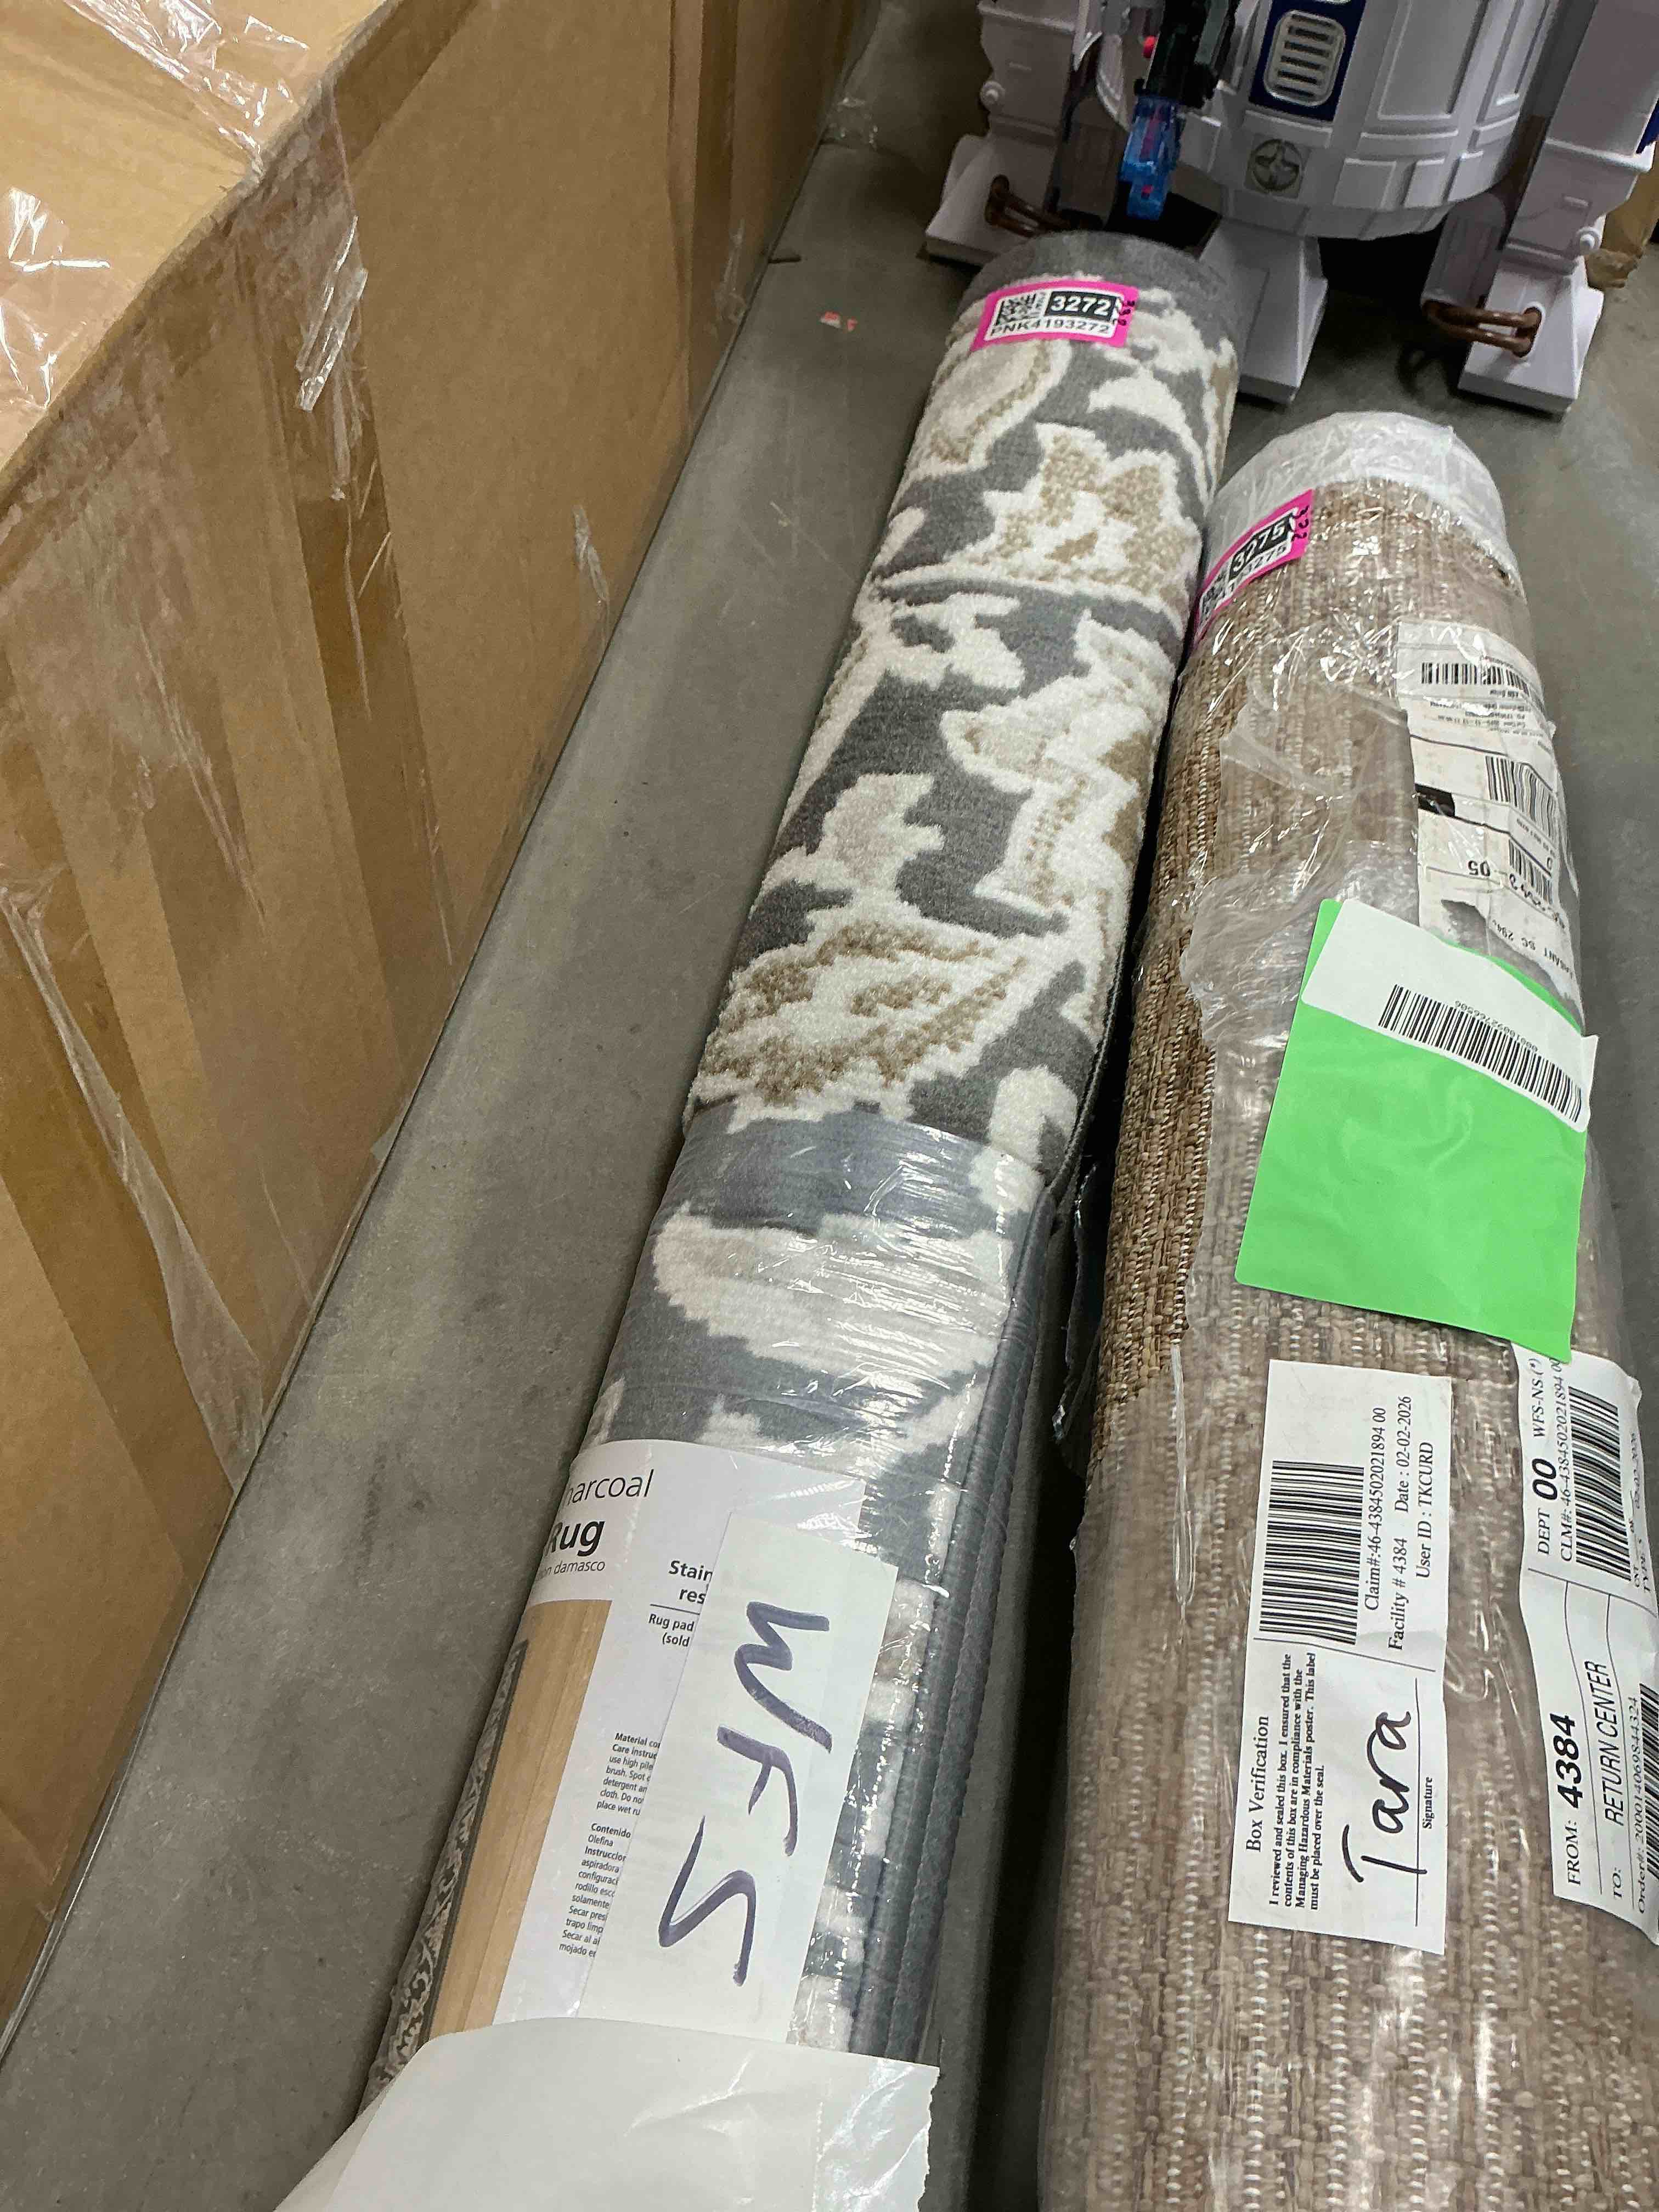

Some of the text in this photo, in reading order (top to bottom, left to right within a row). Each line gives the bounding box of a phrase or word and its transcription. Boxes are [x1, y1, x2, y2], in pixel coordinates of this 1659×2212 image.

[1051, 295, 1111, 316] 3272
[1233, 522, 1286, 572] 3275
[1468, 860, 1491, 877] 05
[1373, 1408, 1386, 1423] 00
[1531, 1378, 1545, 1437] WFS-NS
[1396, 1396, 1412, 1467] 02-02-2026
[1417, 1442, 1434, 1507] TKCURD
[1532, 1458, 1558, 1500] 00
[1394, 1480, 1409, 1513] Date
[1418, 1521, 1432, 1539] ID
[1537, 1508, 1550, 1554] DEPT
[1392, 1538, 1408, 1574] 4384
[1415, 1543, 1431, 1578] User
[554, 1560, 606, 1575] damasco
[1392, 1577, 1406, 1588] #
[679, 1588, 707, 1605] res
[648, 1613, 695, 1632] Rug pad
[1388, 1592, 1409, 1650] Facility
[662, 1632, 690, 1647] (sold
[1281, 1654, 1291, 1670] the
[1280, 1673, 1290, 1694] that
[1280, 1696, 1289, 1737] ensured
[612, 1743, 630, 1754] Care
[614, 1733, 648, 1746] Material
[609, 1755, 622, 1764] use
[623, 1756, 639, 1769] high
[606, 1765, 628, 1778] brush.
[629, 1770, 646, 1782] Spot
[1295, 1652, 1316, 1909] Managing Hazardous Materials poster. This label
[1584, 1660, 1624, 1900] TO: RETURN CENTER
[603, 1776, 637, 1791] detergent
[1245, 1716, 1269, 1853] Box Verification
[1277, 1774, 1286, 1793] this
[1285, 1668, 1303, 1907] contents of this box are in compliance with the
[600, 1788, 619, 1800] cloth.
[620, 1792, 631, 1802] Do
[1342, 1711, 1427, 1882] Tara
[1422, 1776, 1435, 1830] Signature
[1550, 1712, 1583, 1886] FROM: 4384
[596, 1800, 617, 1811] place
[618, 1805, 632, 1815] wet
[1275, 1796, 1285, 1825] sealed
[588, 1834, 614, 1847] Olefina
[591, 1823, 632, 1839] Contenido
[1273, 1827, 1283, 1847] and
[1310, 1764, 1325, 1910] must be placed over the seal.
[581, 1859, 619, 1874] aspiradora
[1271, 1849, 1282, 1897] reviewed
[575, 1882, 599, 1894] rodillo
[568, 1905, 589, 1917] Secar
[572, 1894, 610, 1909] solamente
[566, 1917, 585, 1929] trapo
[562, 1929, 582, 1942] Secar
[583, 1935, 592, 1943] al
[558, 1943, 588, 1956] mojado
